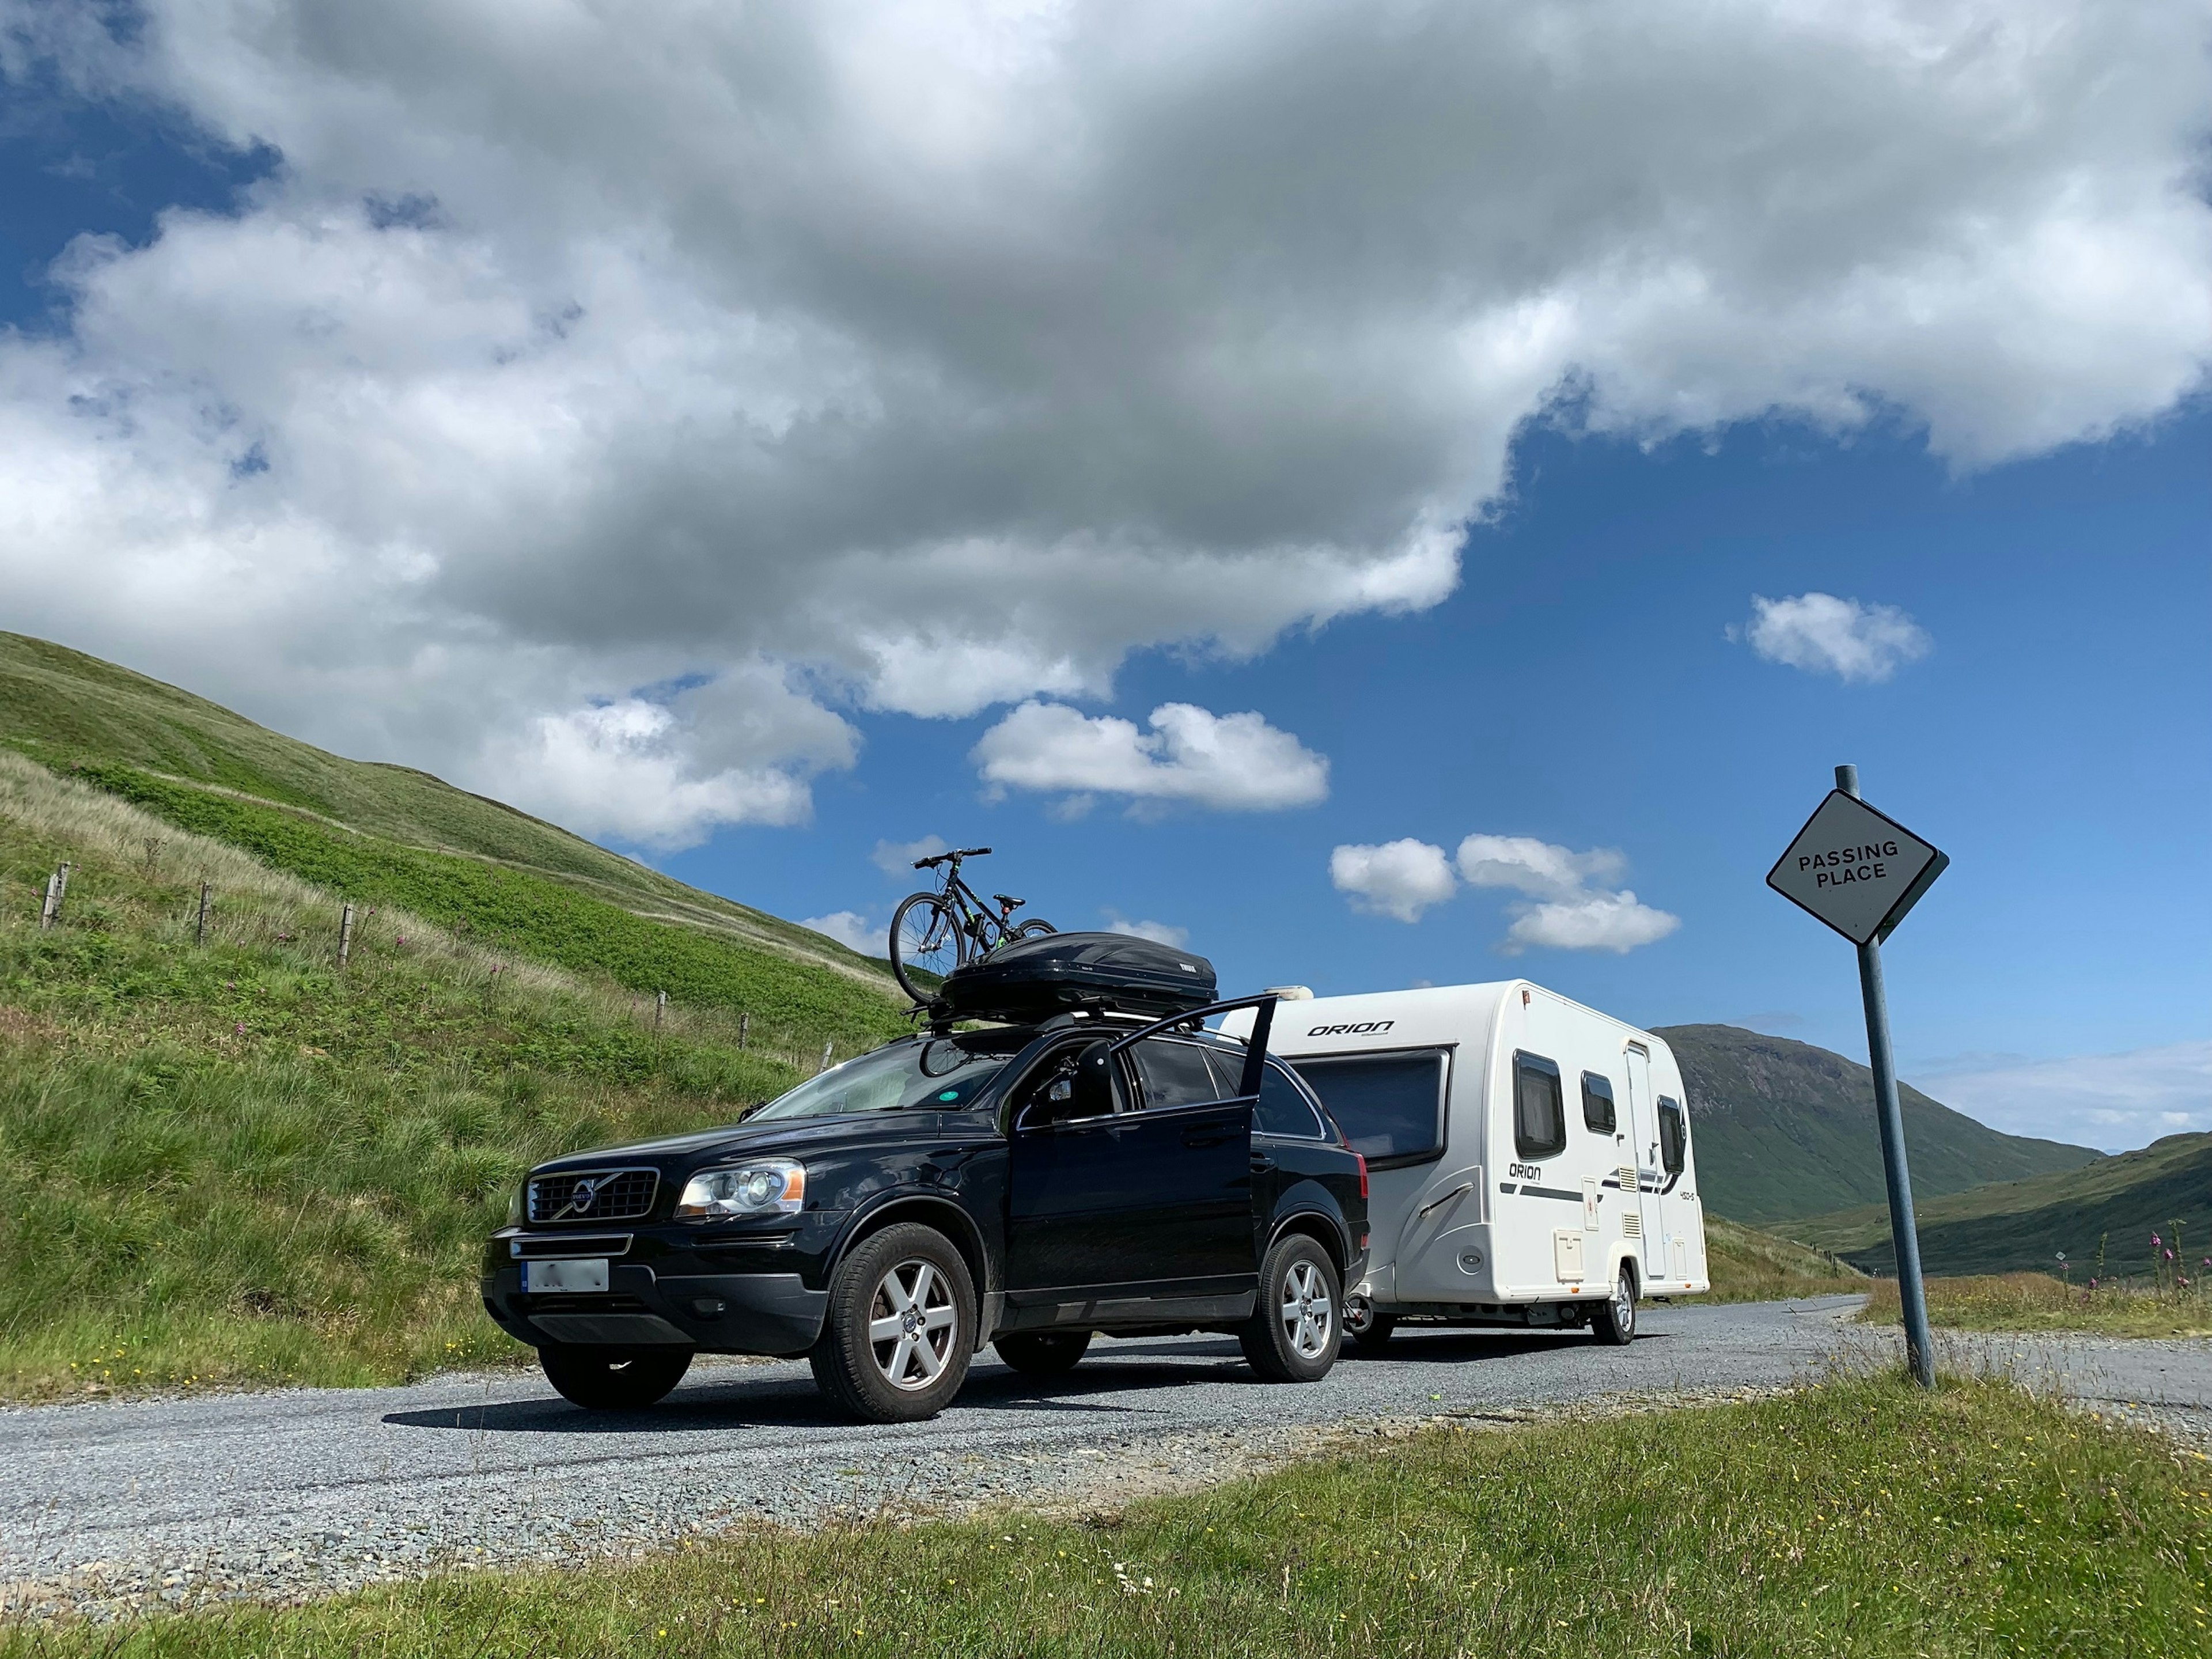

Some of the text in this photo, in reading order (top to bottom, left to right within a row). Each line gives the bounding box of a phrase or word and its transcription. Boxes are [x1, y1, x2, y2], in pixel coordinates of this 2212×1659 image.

[1799, 841, 1898, 871] PASSING
[1817, 863, 1887, 888] PLACE
[1307, 1021, 1395, 1036] ORION
[1509, 1163, 1541, 1180] ORION
